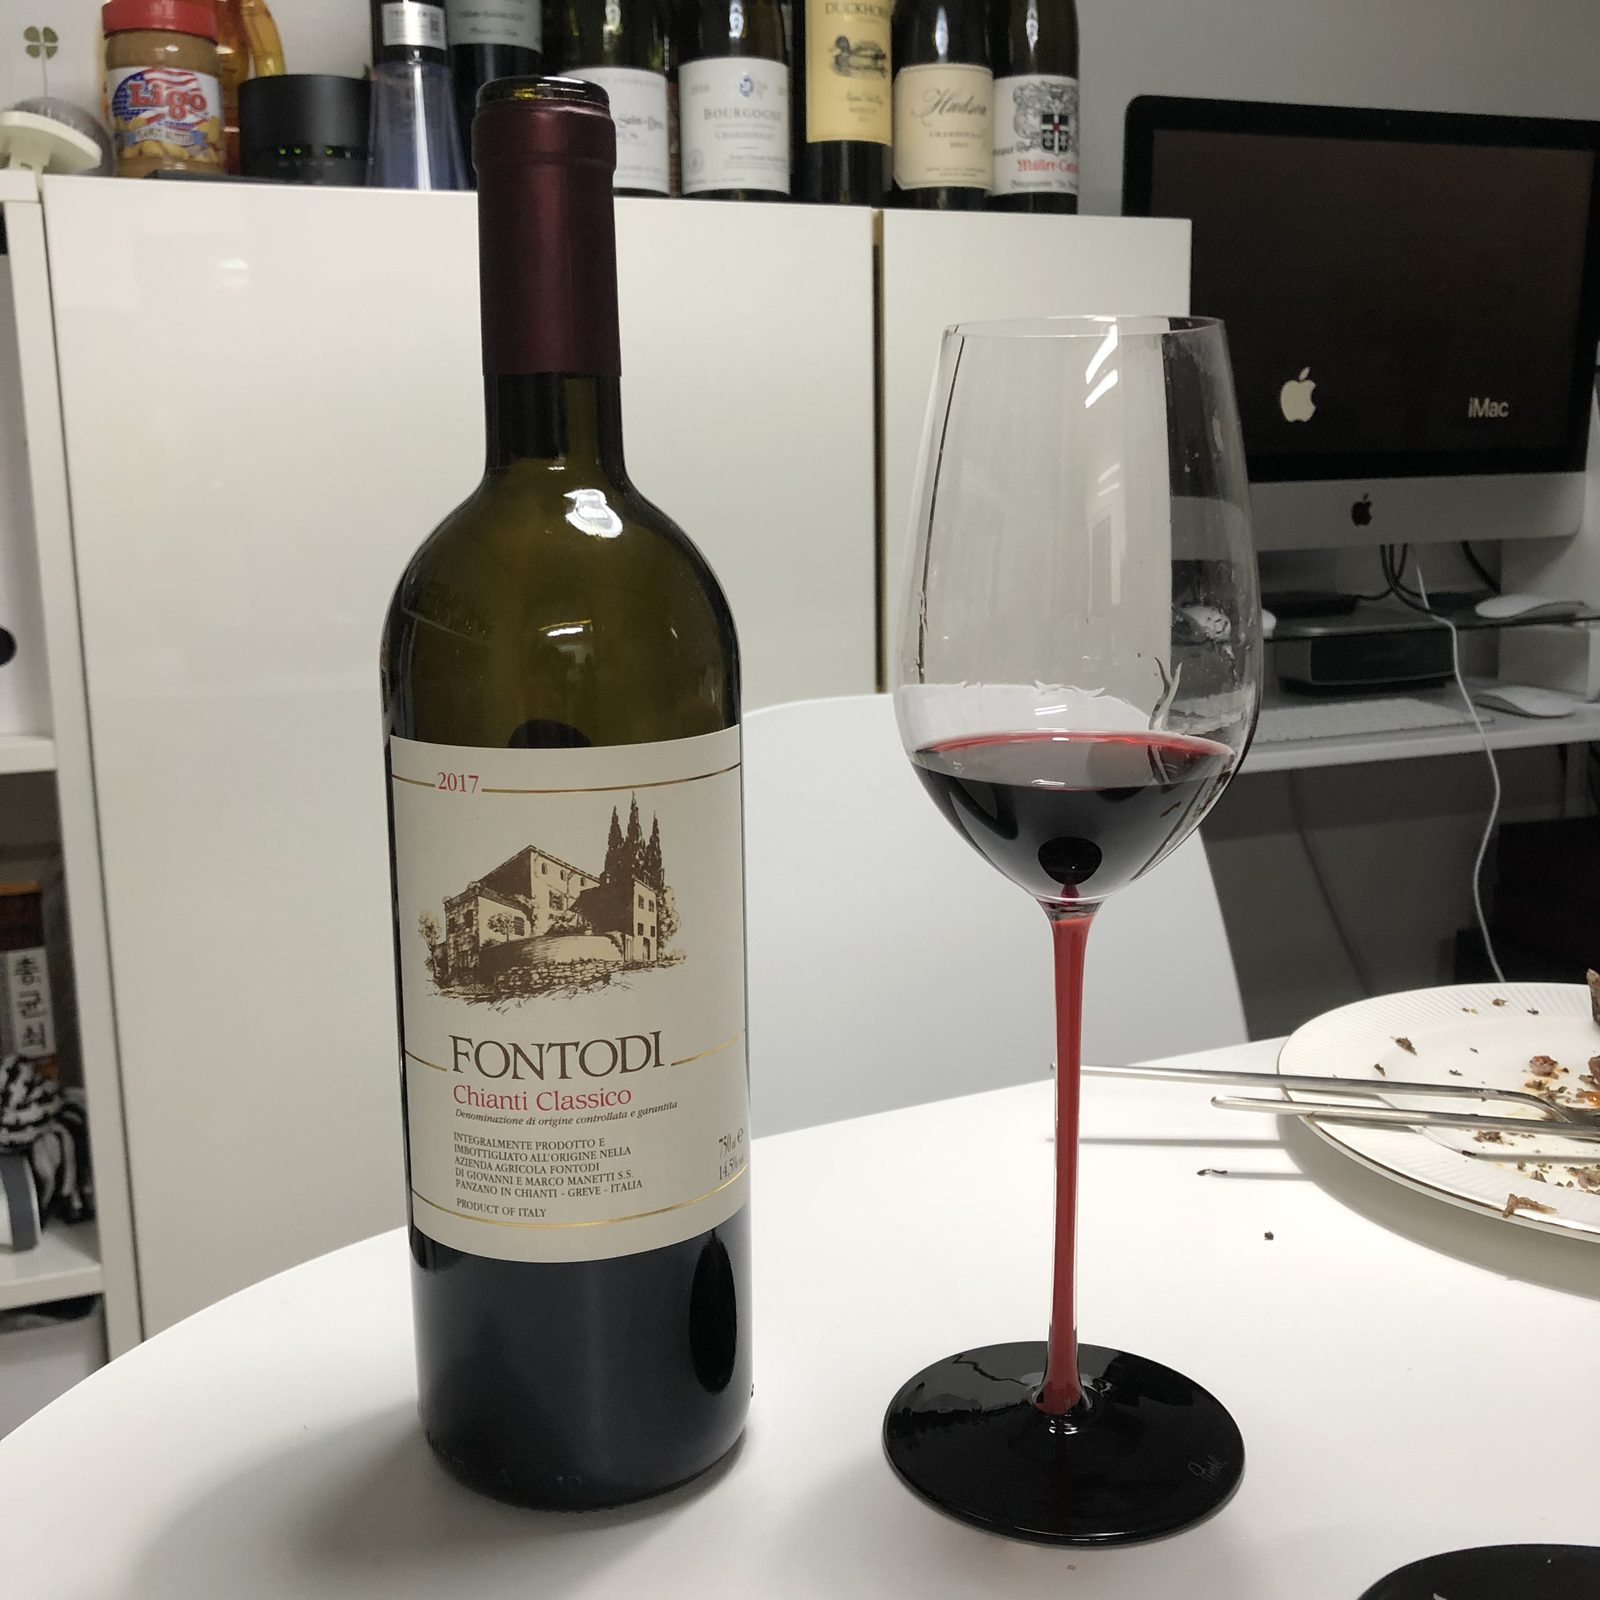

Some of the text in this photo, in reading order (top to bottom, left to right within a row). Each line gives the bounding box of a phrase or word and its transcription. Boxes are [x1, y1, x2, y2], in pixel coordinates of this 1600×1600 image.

[127, 81, 207, 120] Ligo
[1468, 397, 1509, 418] iMac
[437, 771, 479, 794] 2017
[448, 1030, 665, 1081] FONTODI
[453, 1084, 632, 1111] Chianti Classico
[455, 1101, 678, 1128] Denominazione di origine controllata e garantita
[453, 1131, 605, 1151] INTEGRALMENTE PRODOTTO E
[454, 1143, 632, 1163] IMBOTTIGLIATO ALL'ORIGINE NELLA
[455, 1156, 600, 1175] AZIENDA AGRICOLA FONTODI
[455, 1167, 464, 1178] DI
[466, 1170, 513, 1185] GIOVANNI
[516, 1177, 522, 1186] E
[525, 1176, 564, 1187] MARCO
[567, 1172, 615, 1186] MANETTI
[455, 1178, 498, 1195] PANZANO
[500, 1187, 512, 1197] IN
[514, 1188, 557, 1198] CHIANTI
[567, 1186, 601, 1198] GREVE
[610, 1179, 643, 1193] ITALIA
[456, 1197, 547, 1218] PRODUCT OF ITALY
